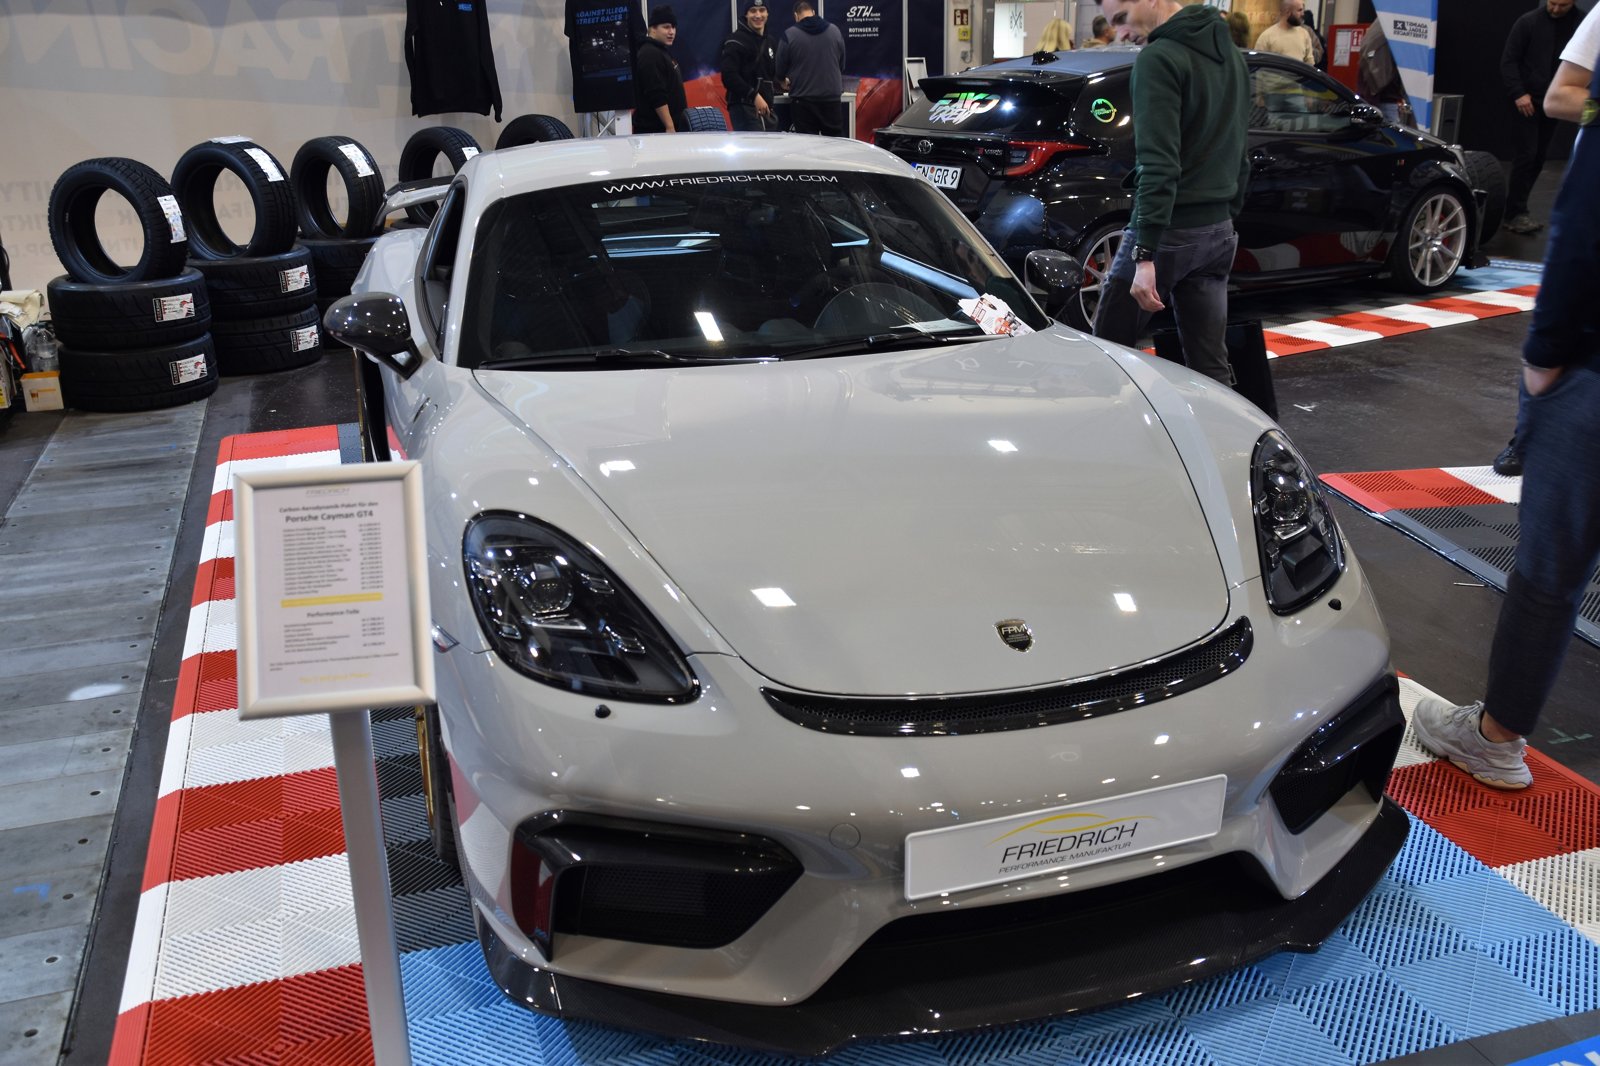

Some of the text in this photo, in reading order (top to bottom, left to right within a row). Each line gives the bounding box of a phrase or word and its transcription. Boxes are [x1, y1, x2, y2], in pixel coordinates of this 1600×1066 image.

[605, 6, 628, 15] ILLEGA
[846, 5, 874, 17] STW
[600, 14, 623, 22] RACES
[933, 167, 949, 185] GR
[950, 170, 959, 186] 9
[603, 174, 838, 194] WWW.FRIEDRICH-PM.COM
[285, 510, 374, 523] Porsche Cayman GT4
[1001, 625, 1025, 635] FPM
[1001, 821, 1139, 864] FRIEDRICH
[998, 841, 1132, 874] PERFORMANCE MANUFAKTUR
